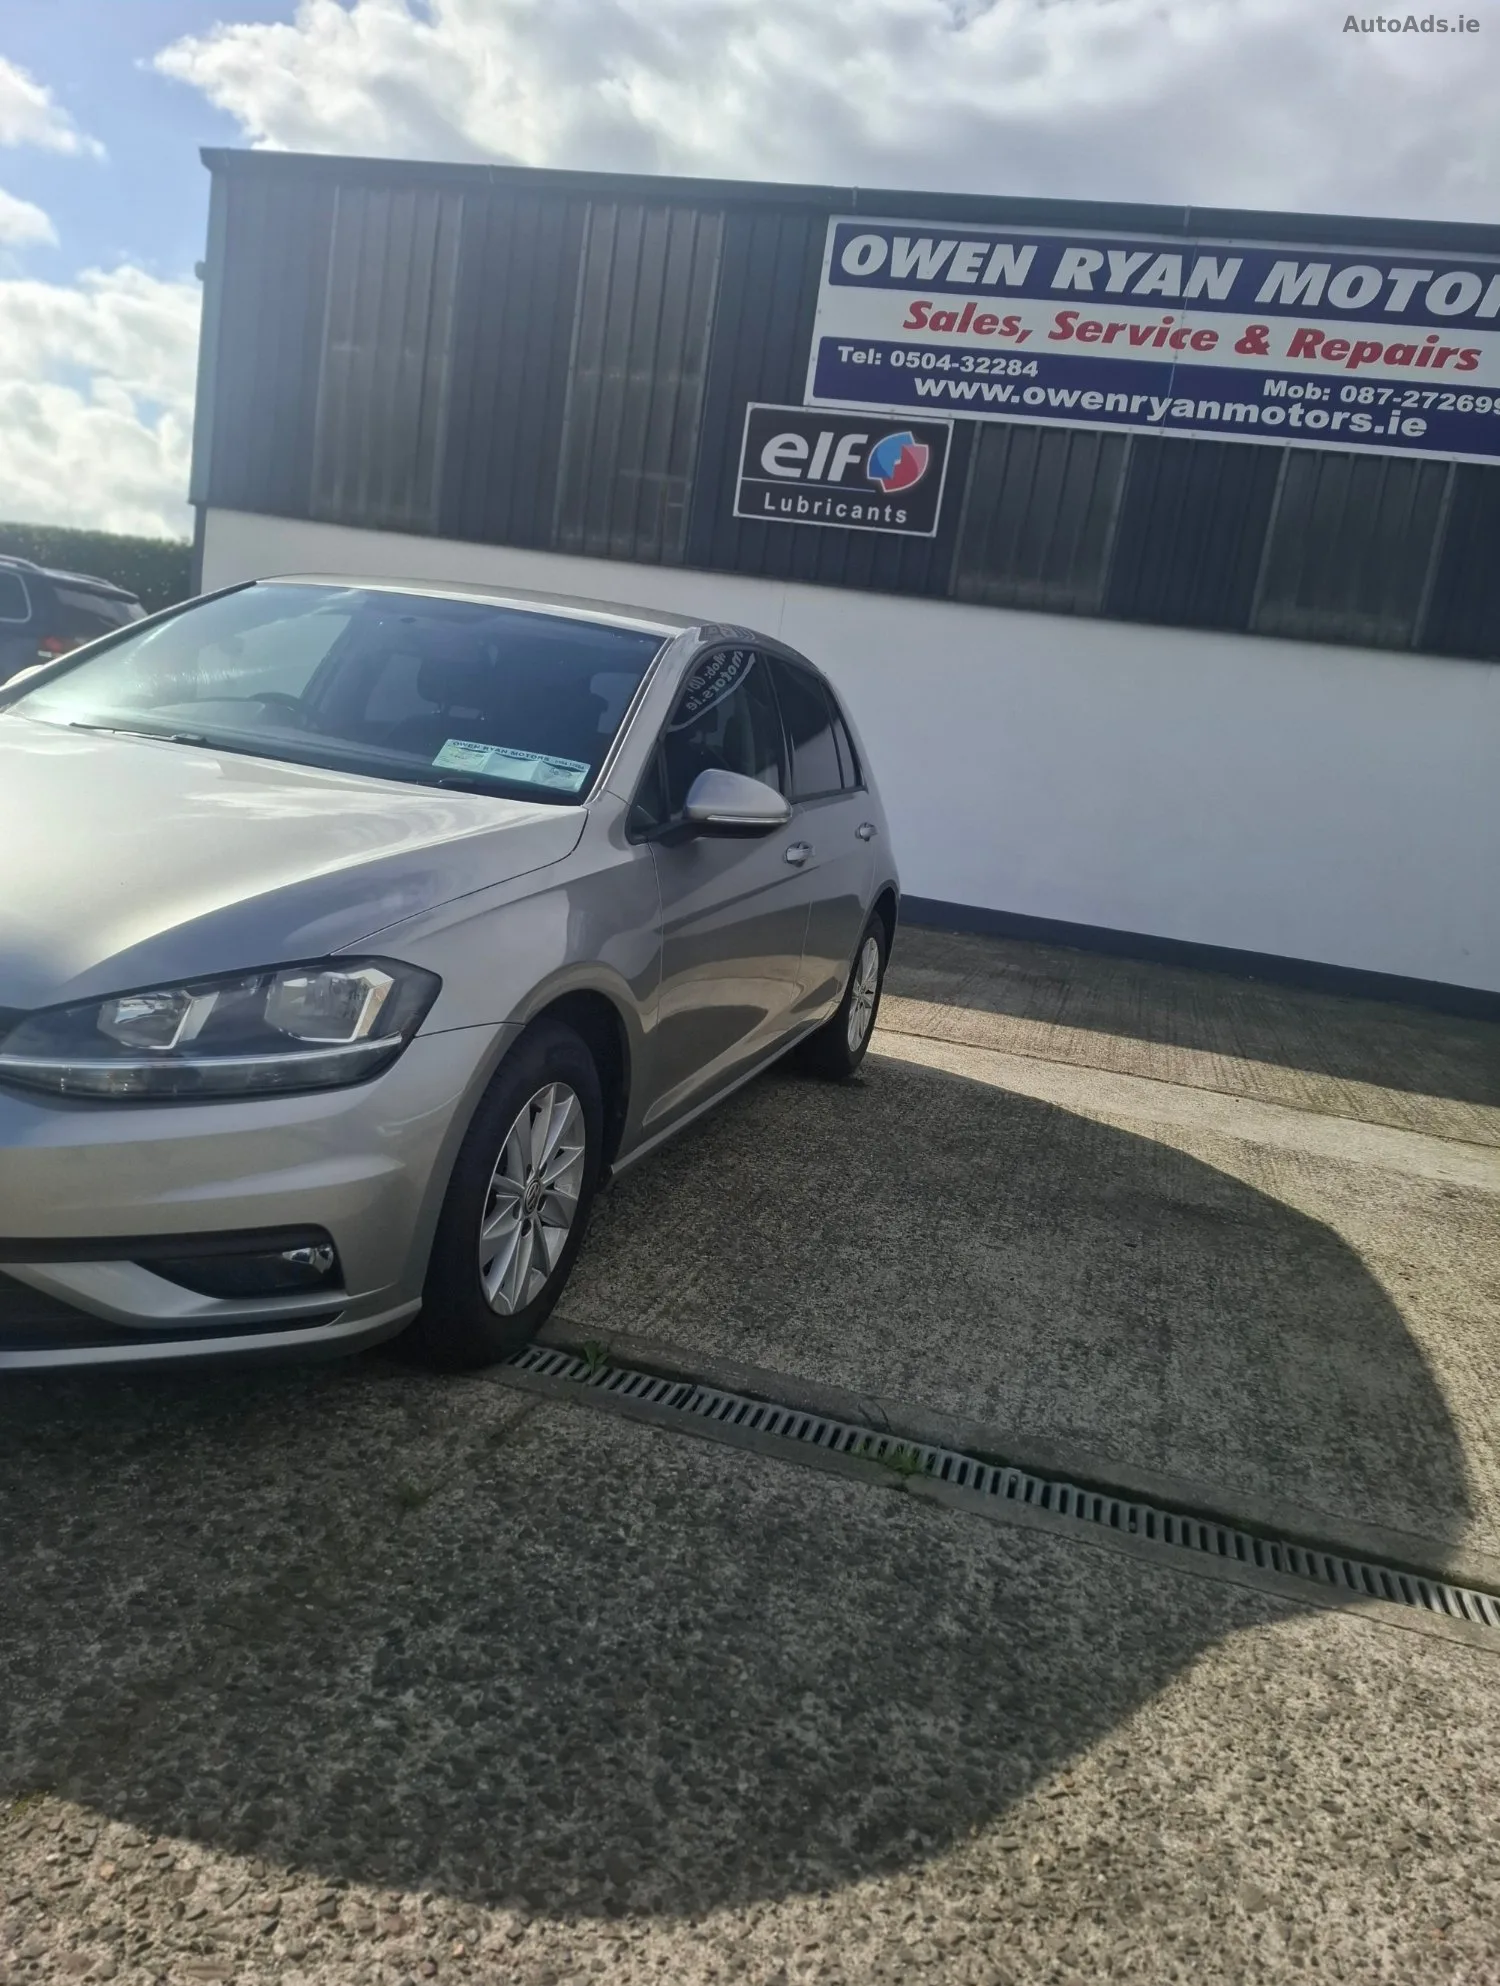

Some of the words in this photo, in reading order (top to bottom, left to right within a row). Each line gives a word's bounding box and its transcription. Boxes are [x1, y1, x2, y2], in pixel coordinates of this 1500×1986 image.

[841, 234, 1039, 286] OWEN
[1050, 247, 1244, 300] RYAN
[903, 300, 1034, 344] Sales,
[1048, 310, 1220, 351] Service
[1234, 324, 1271, 356] &
[1286, 327, 1483, 371] Repairs
[837, 346, 882, 366] Tel:
[889, 350, 1039, 377] 0504-32284
[914, 377, 1428, 437] www.owenryanmotors.ie
[1263, 379, 1331, 401] Mob:
[760, 431, 869, 482] elf
[763, 492, 908, 524] Lubricants
[452, 740, 481, 749] OWEN
[483, 745, 508, 754] RYAN
